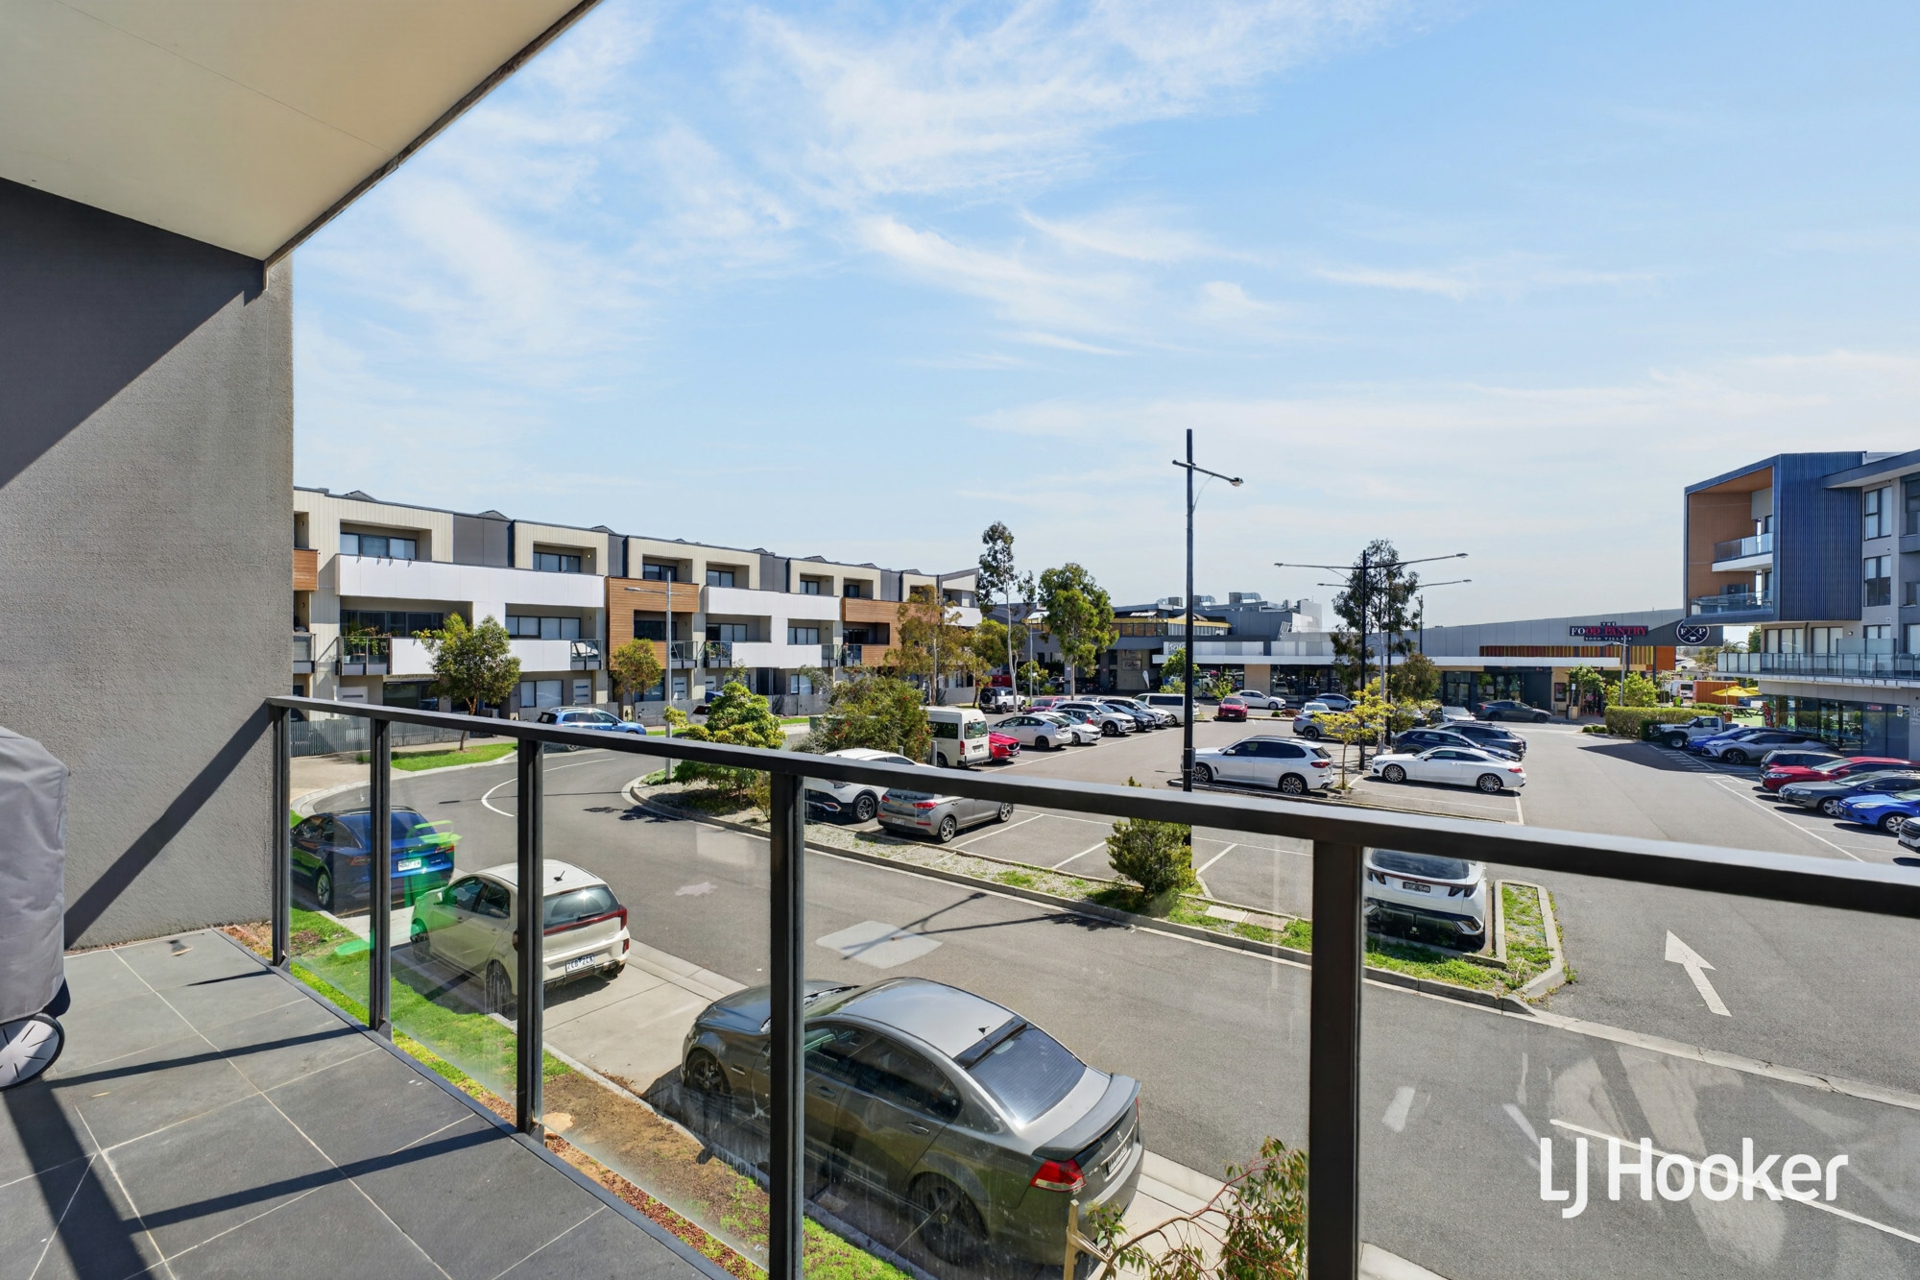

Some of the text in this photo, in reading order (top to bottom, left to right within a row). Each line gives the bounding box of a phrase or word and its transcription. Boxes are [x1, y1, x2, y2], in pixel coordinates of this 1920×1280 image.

[1571, 627, 1647, 636] FOOD PANTRY
[1680, 627, 1706, 635] F P
